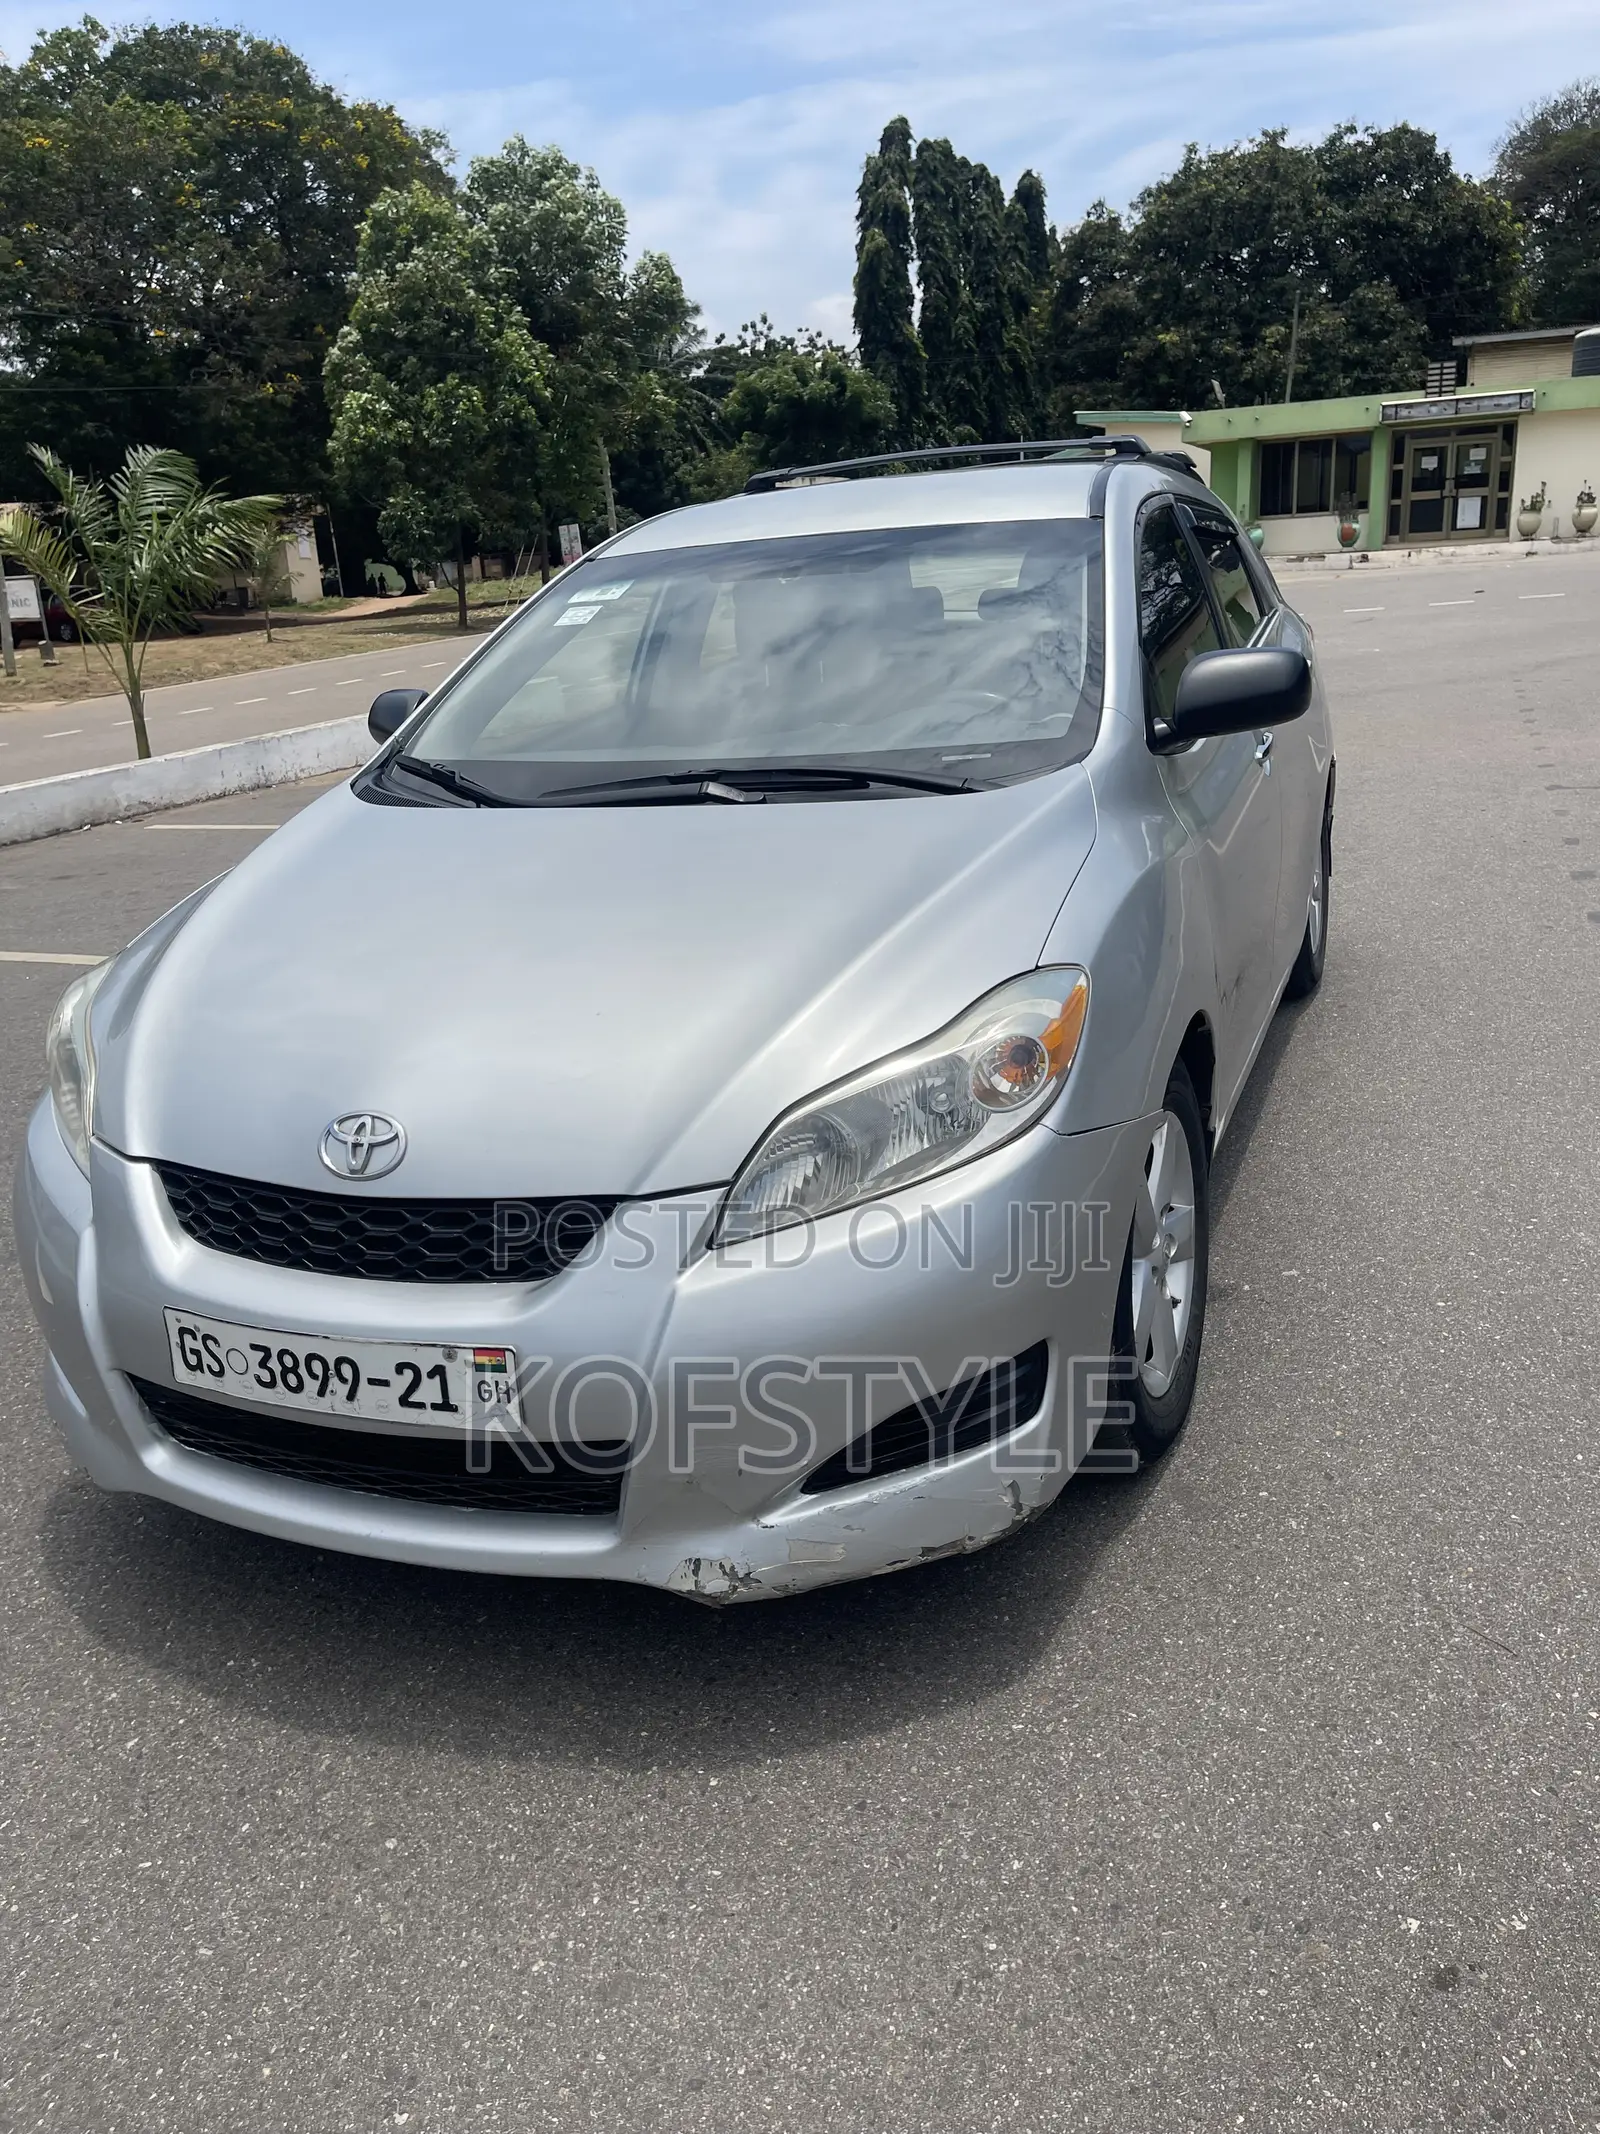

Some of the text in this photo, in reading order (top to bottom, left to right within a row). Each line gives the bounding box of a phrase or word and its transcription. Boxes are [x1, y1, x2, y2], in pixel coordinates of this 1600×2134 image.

[178, 1326, 459, 1412] GS 3899-21
[477, 1380, 511, 1404] GH
